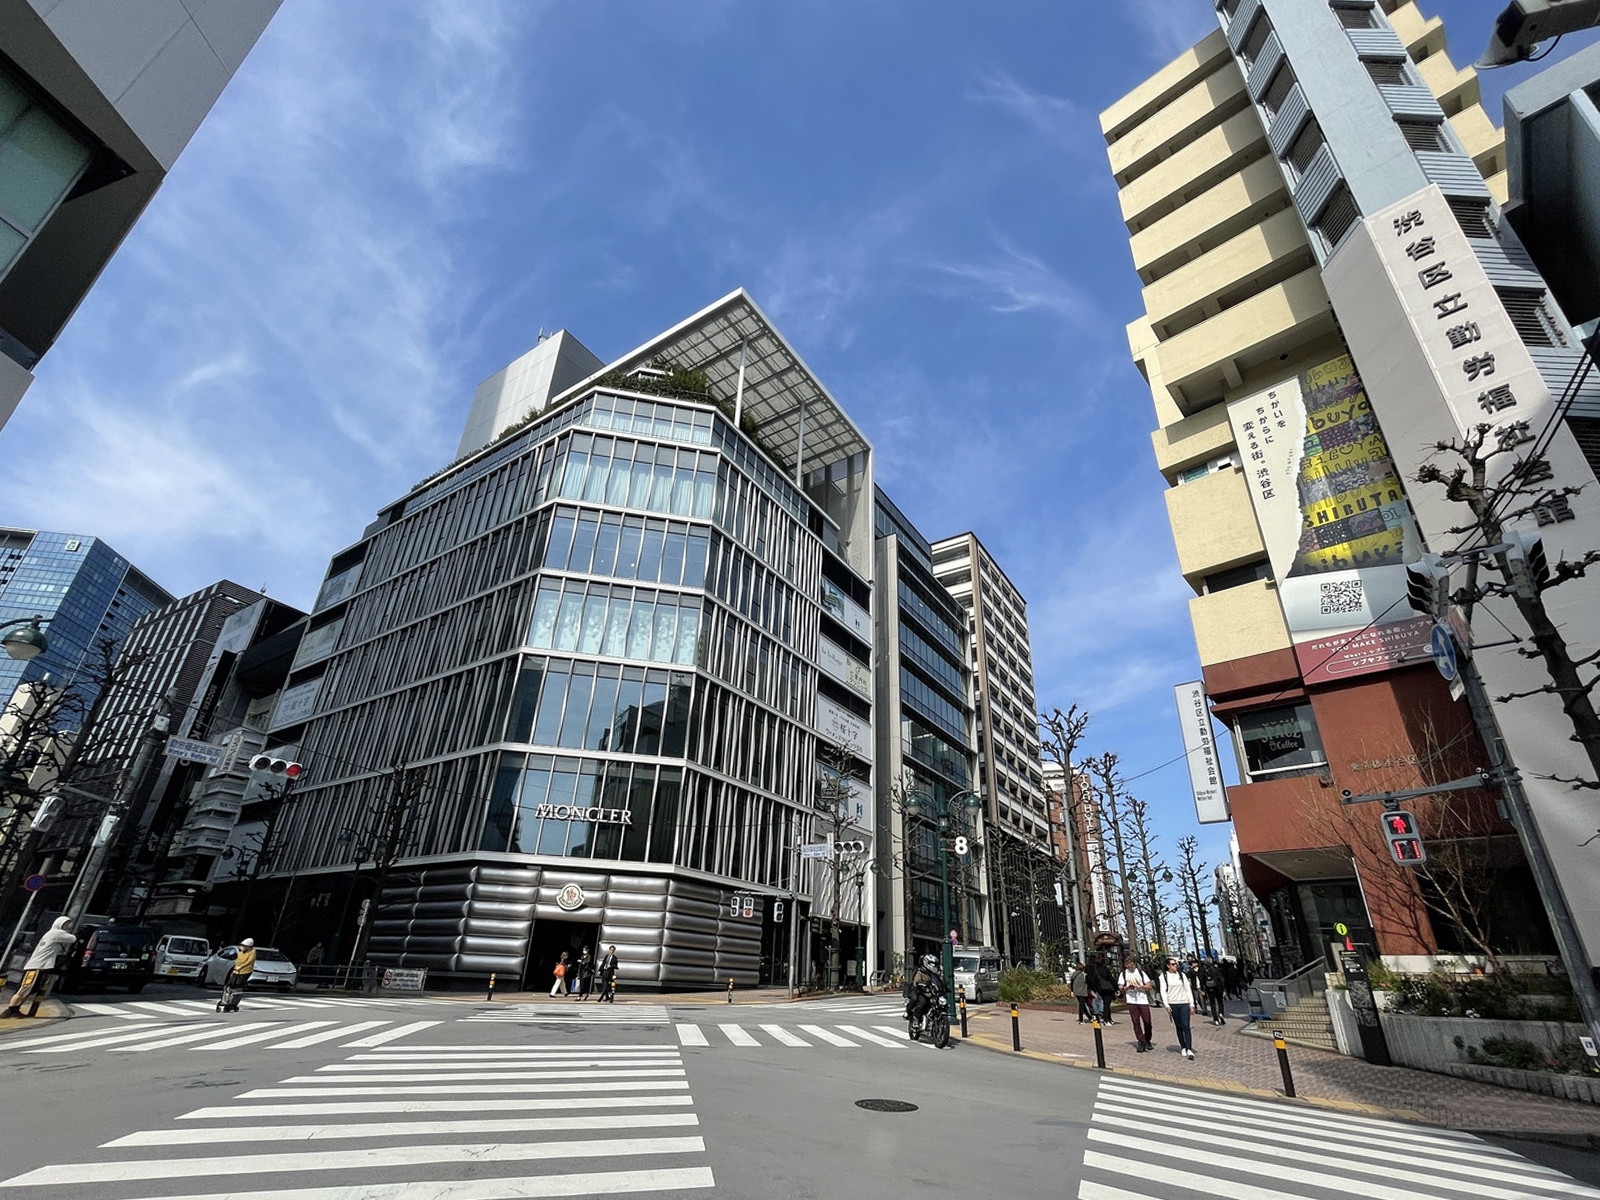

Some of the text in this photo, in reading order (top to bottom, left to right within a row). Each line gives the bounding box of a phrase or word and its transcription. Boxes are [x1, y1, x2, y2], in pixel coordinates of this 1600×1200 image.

[1268, 390, 1287, 428] ちがいを
[1256, 406, 1275, 444] ちからに
[1352, 639, 1376, 649] MAKE
[1380, 631, 1420, 643] SHIBUYA
[1276, 740, 1299, 750] Coffee
[535, 803, 633, 825] MONCLER
[954, 836, 968, 855] 8
